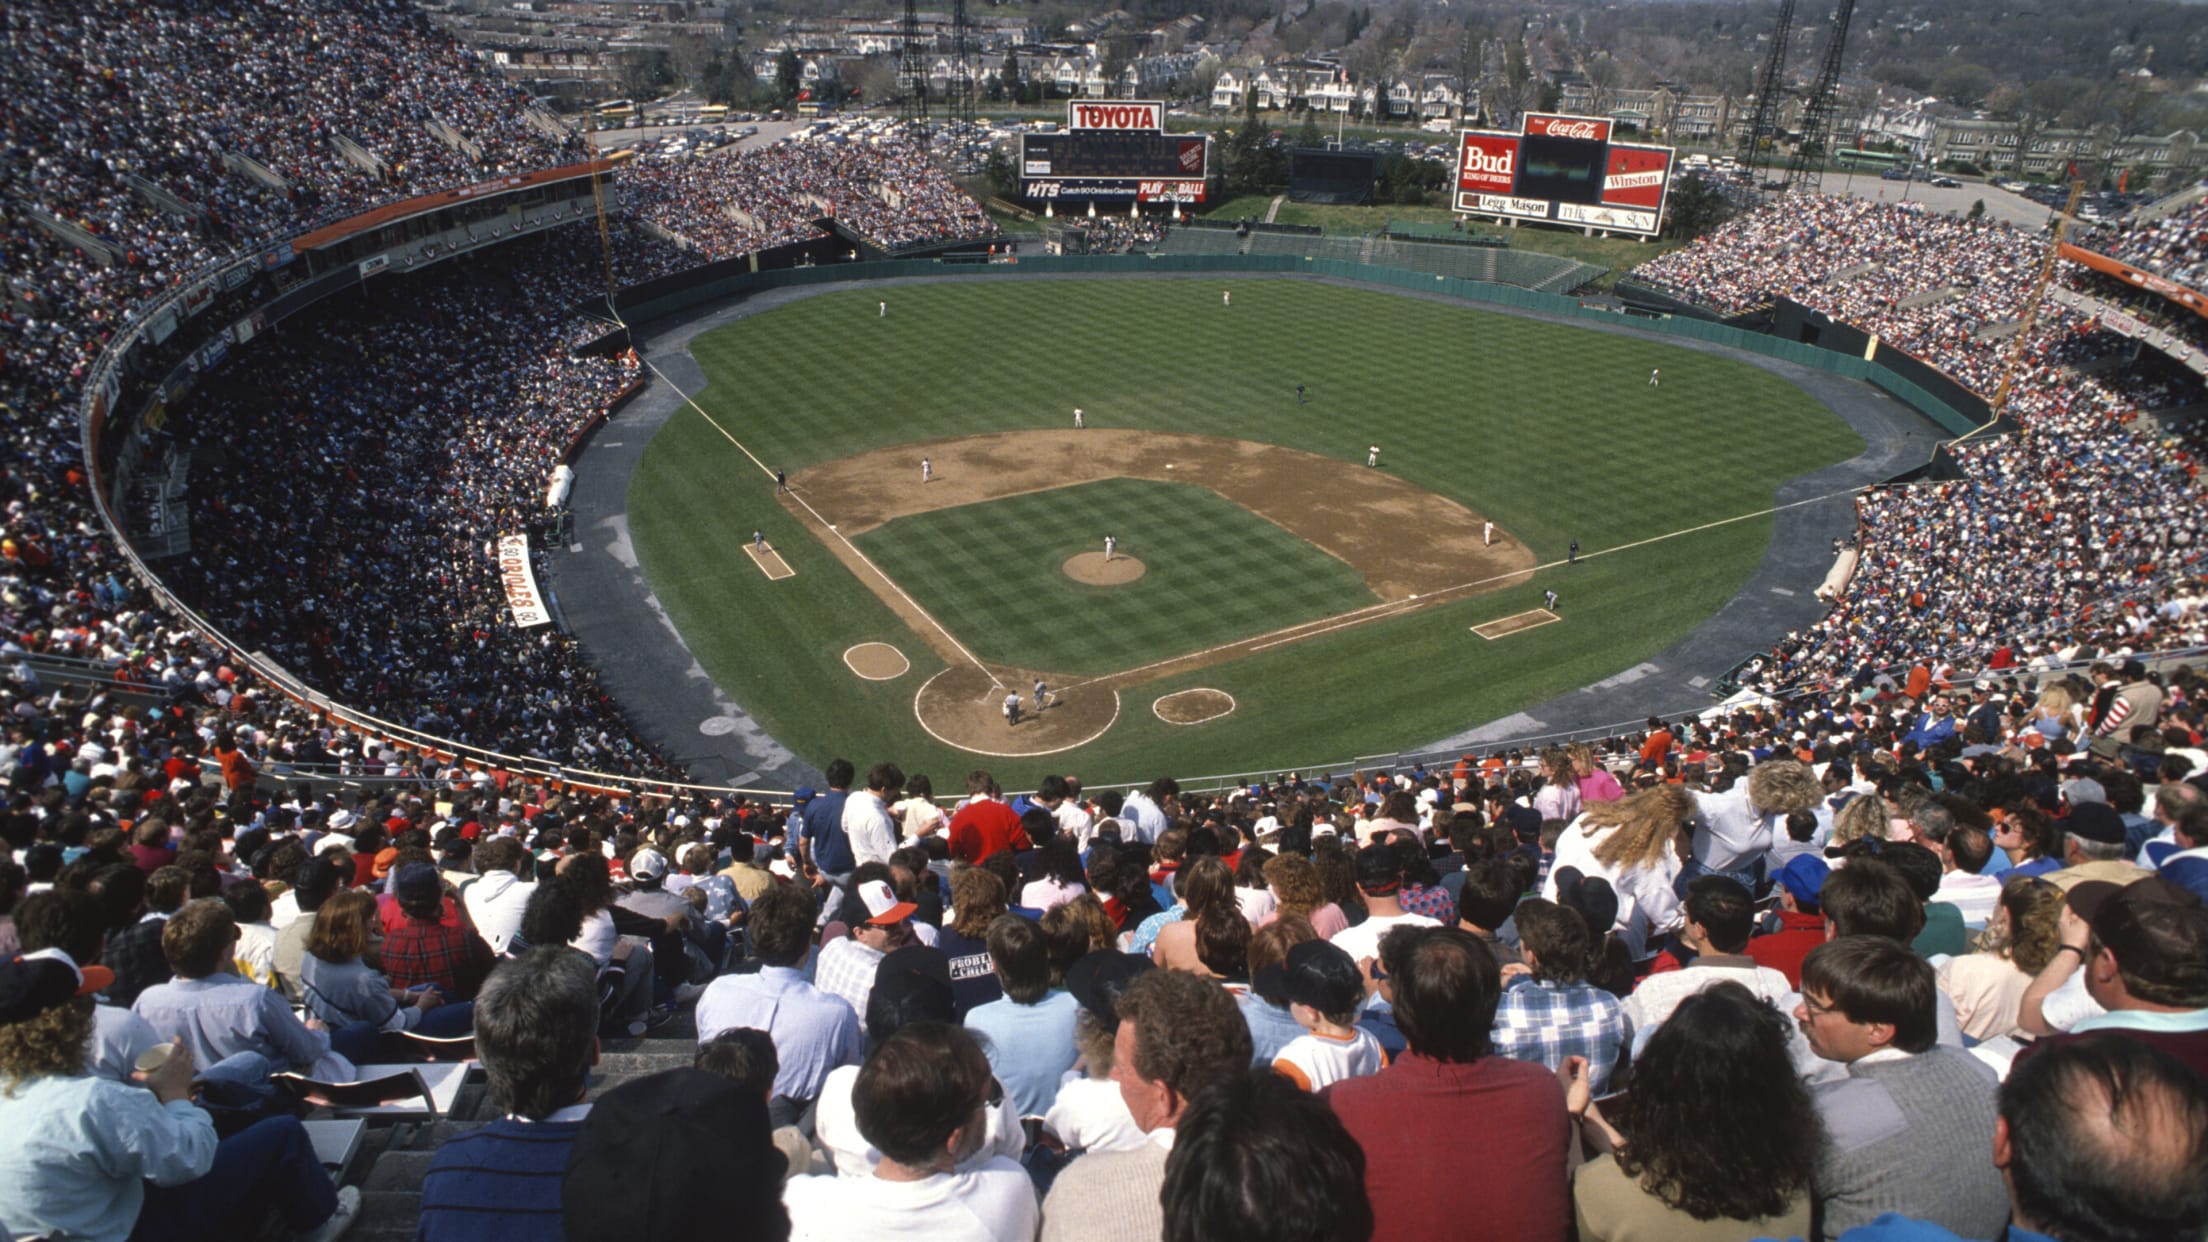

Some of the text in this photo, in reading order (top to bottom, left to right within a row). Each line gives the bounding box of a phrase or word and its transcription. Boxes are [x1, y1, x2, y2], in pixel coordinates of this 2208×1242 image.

[1078, 106, 1154, 128] TOYOTA
[1465, 146, 1513, 174] Bud
[1026, 182, 1060, 197] HTS
[1140, 182, 1163, 194] PLAY
[1610, 174, 1658, 187] Winston
[1482, 195, 1545, 213] Legg Mason
[1562, 207, 1650, 227] THE SUN
[503, 547, 520, 557] GO
[503, 558, 535, 607] ORIOLES
